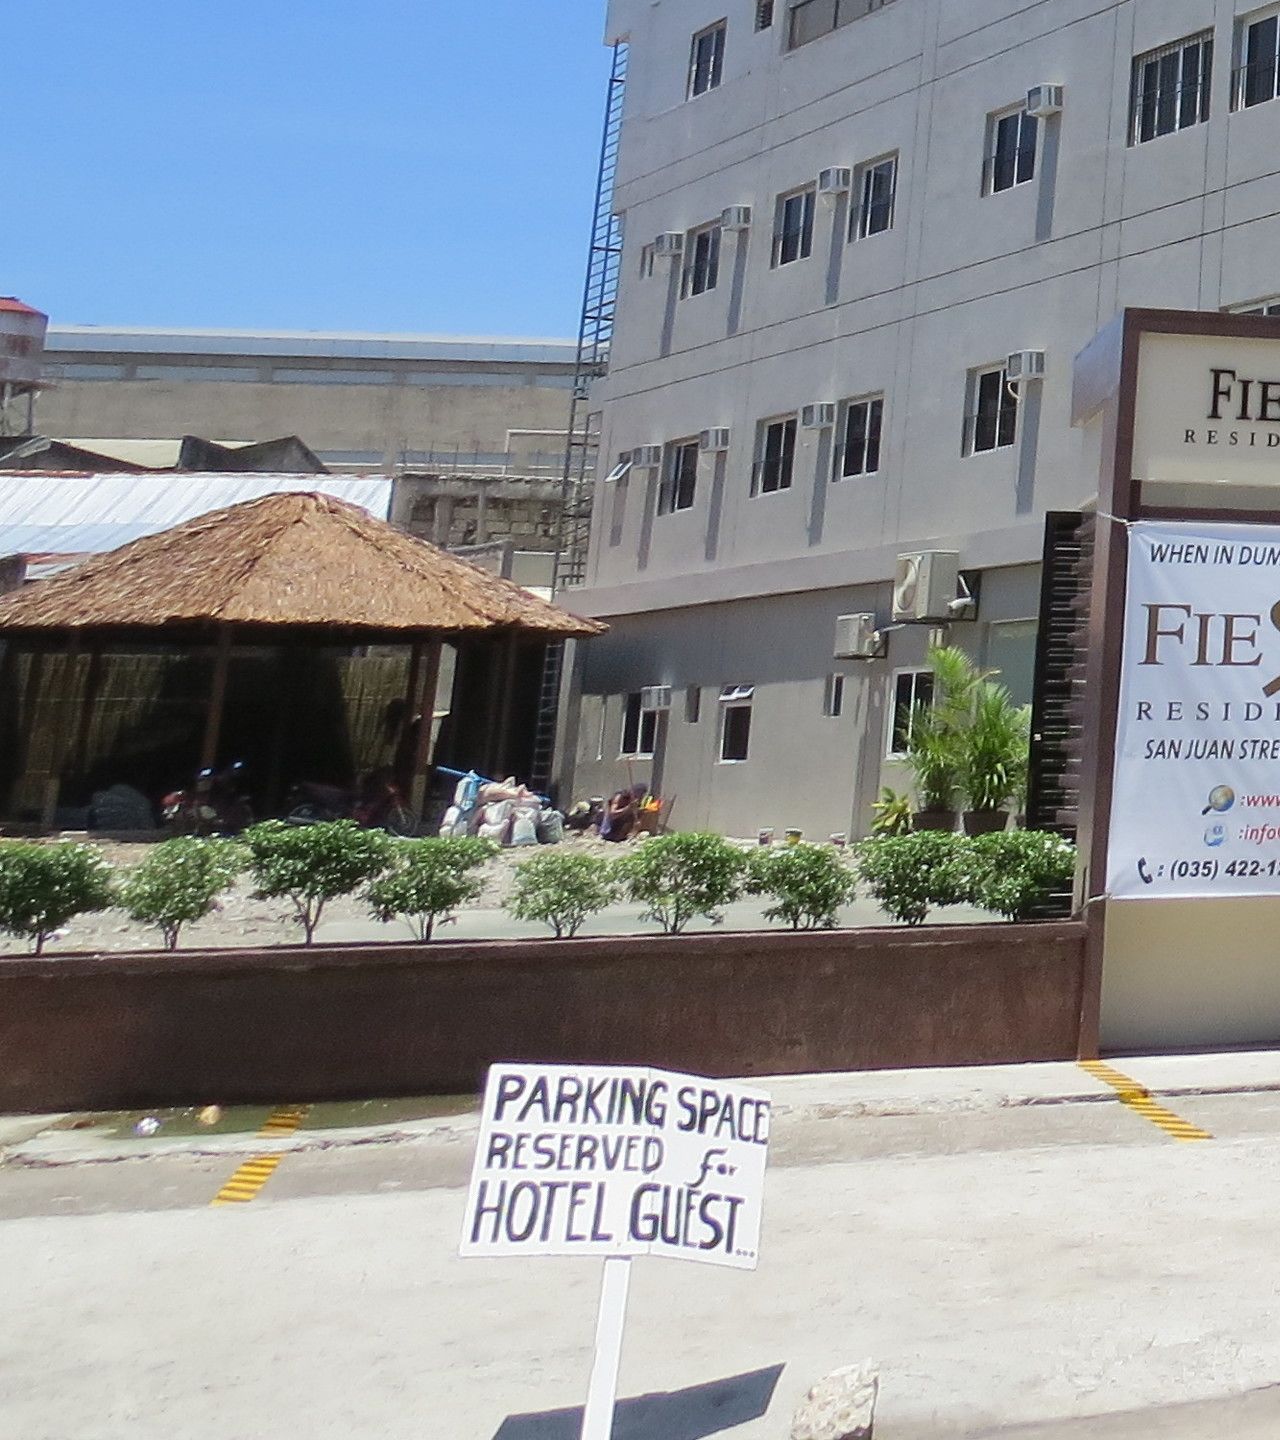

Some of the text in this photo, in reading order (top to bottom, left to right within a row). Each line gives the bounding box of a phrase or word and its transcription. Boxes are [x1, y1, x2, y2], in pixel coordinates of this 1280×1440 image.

[1150, 543, 1209, 564] WHEN
[1213, 545, 1235, 564] IN
[1144, 739, 1182, 760] SAN
[1184, 739, 1235, 760] JUAN
[1170, 859, 1219, 879] (035)
[493, 1074, 771, 1145] PARKING SPACE
[485, 1132, 737, 1188] RESERVED for
[470, 1180, 612, 1243] HOTEL
